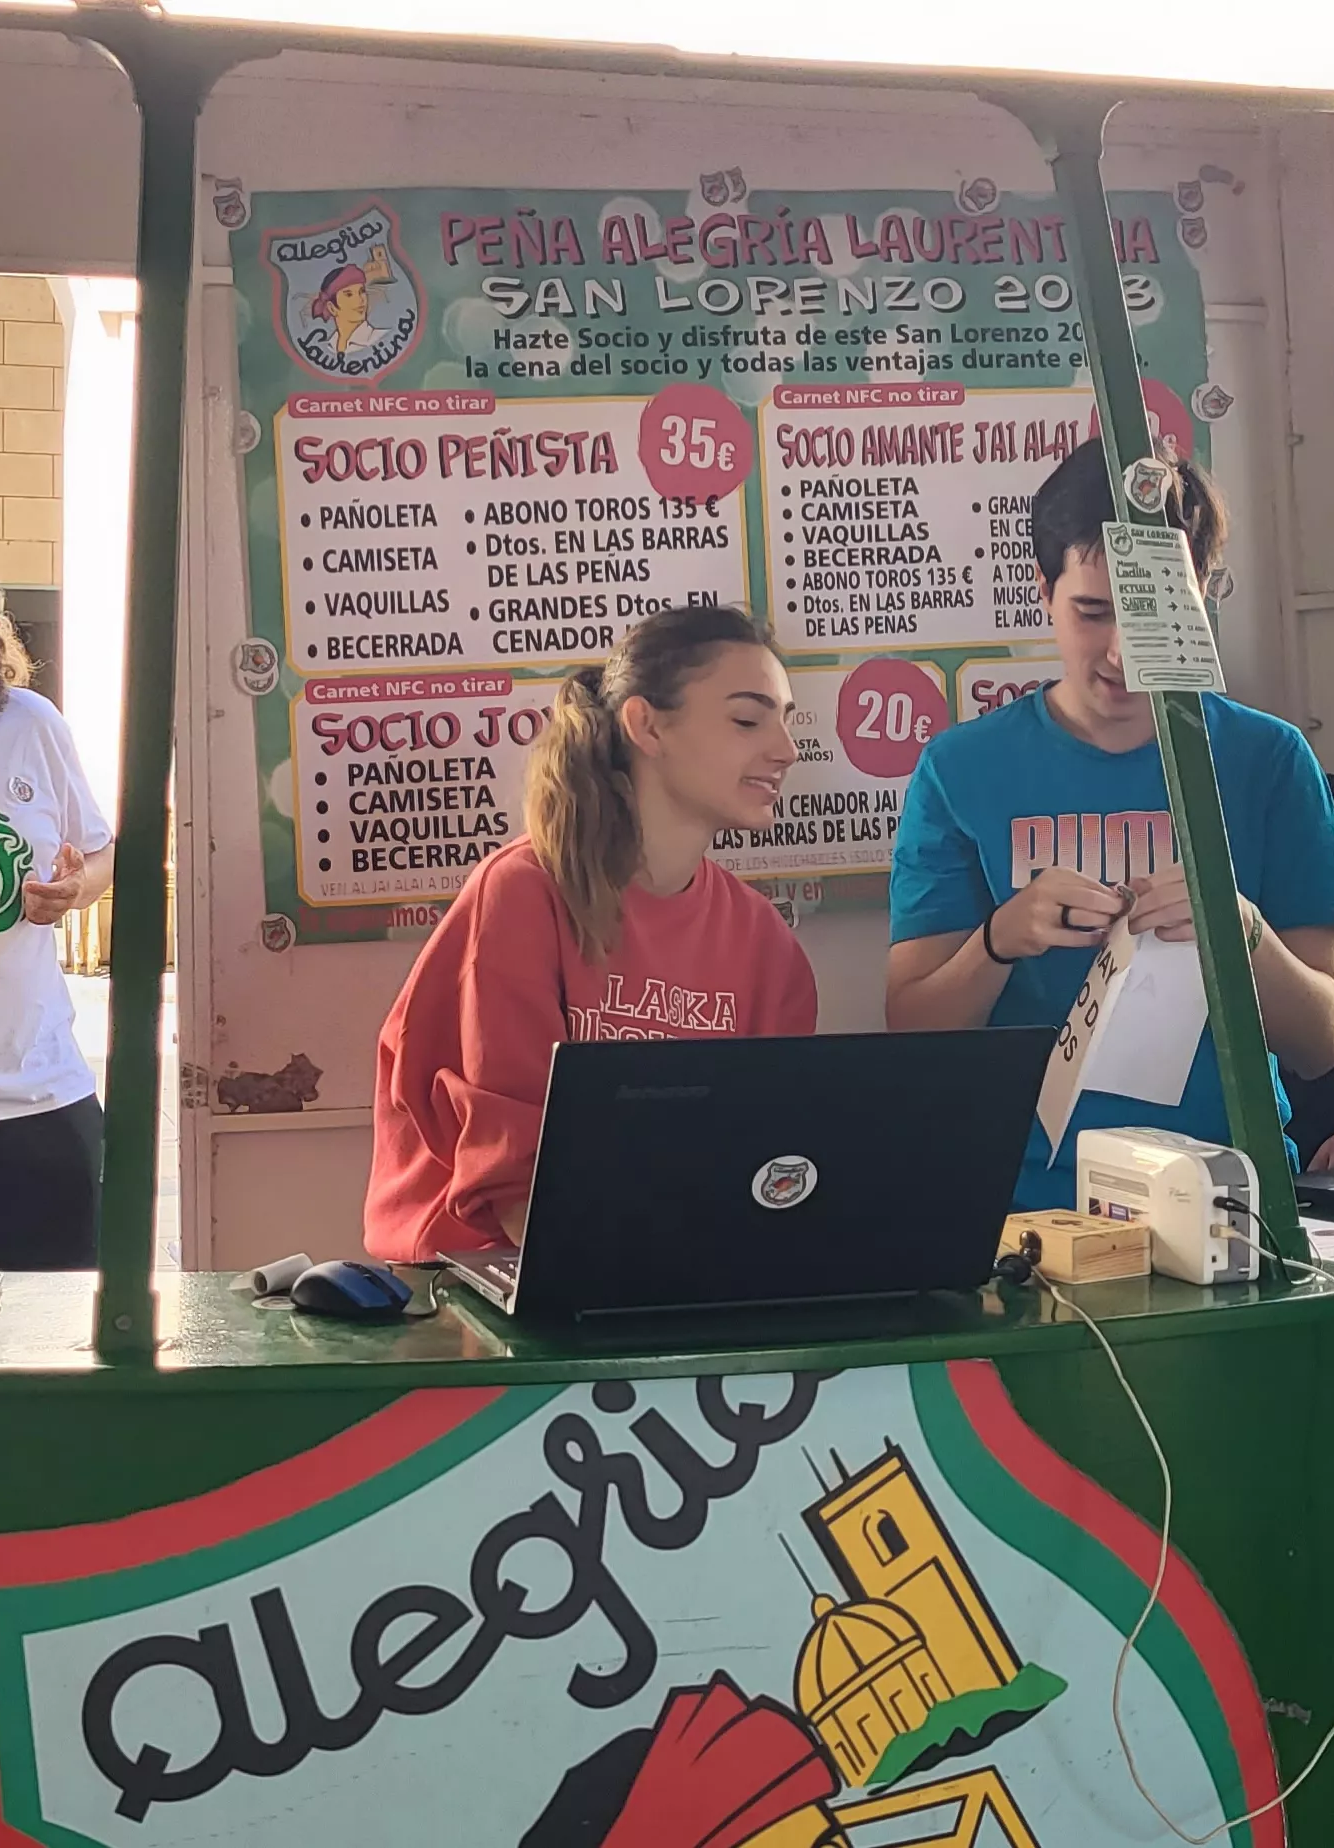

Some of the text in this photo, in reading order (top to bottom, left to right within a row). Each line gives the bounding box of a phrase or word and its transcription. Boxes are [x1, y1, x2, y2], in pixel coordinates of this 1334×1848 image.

[440, 206, 1159, 267] PEÑA ALEGRÍA LAURENTA
[481, 273, 1156, 320] SAN LORENZO 203
[298, 309, 417, 378] Laurentina
[494, 329, 569, 351] Hazte
[578, 328, 650, 349] Socio
[658, 332, 674, 354] y
[682, 324, 787, 348] disfruta
[795, 324, 827, 346] de
[835, 326, 887, 346] este
[896, 323, 941, 344] San
[951, 321, 1050, 343] Lorenzo
[466, 356, 489, 378] la
[497, 360, 563, 377] cena
[570, 355, 616, 377] del
[620, 356, 690, 376] socio
[696, 360, 713, 380] y
[721, 352, 796, 375] todas
[804, 351, 838, 372] las
[845, 348, 955, 376] ventajas
[962, 348, 1062, 370] durante
[296, 395, 489, 414] Carnet NFC no tirar
[780, 387, 959, 406] Carnet NFC no tirar
[294, 427, 619, 484] SOCIO PEÑISTA
[776, 418, 1079, 469] SOCIO AMANTE JAI ALAI
[800, 474, 919, 499] PAÑOLETA
[319, 497, 438, 530] PAÑOLETA
[484, 495, 720, 526] ABONO TOROS 135 €
[801, 500, 919, 522] CAMISETA
[486, 525, 729, 557] Dtos. EN LAS BARRAS
[802, 522, 930, 546] VAQUILLAS
[989, 518, 1011, 537] EN
[322, 546, 439, 574] CAMISETA
[488, 552, 651, 588] DE LAS PEÑAS
[803, 545, 942, 568] BECERRADA
[803, 566, 974, 591] ABONO TOROS 135 €
[992, 565, 1003, 583] A
[324, 588, 450, 619] VAQUILLAS
[488, 594, 608, 623] GRANDES
[803, 588, 975, 614] Dtos. EN LAS BARRAS
[805, 606, 919, 637] DE LAS PEÑAS
[995, 610, 1011, 629] EL
[327, 631, 464, 660] BECERRADA
[492, 624, 613, 655] CENADOR
[313, 678, 505, 699] Carnet NFC no tirar
[312, 710, 461, 756] SOCIO
[347, 754, 496, 787] PAÑOLETA
[348, 785, 496, 815] CAMISETA
[789, 790, 869, 818] CENADOR
[874, 789, 898, 812] JAI
[350, 811, 509, 844] VAQUILLAS
[750, 821, 818, 847] BARRAS
[824, 820, 846, 843] DE
[851, 816, 883, 842] LAS
[1011, 810, 1179, 889] PUM
[599, 973, 737, 1033] LASKA
